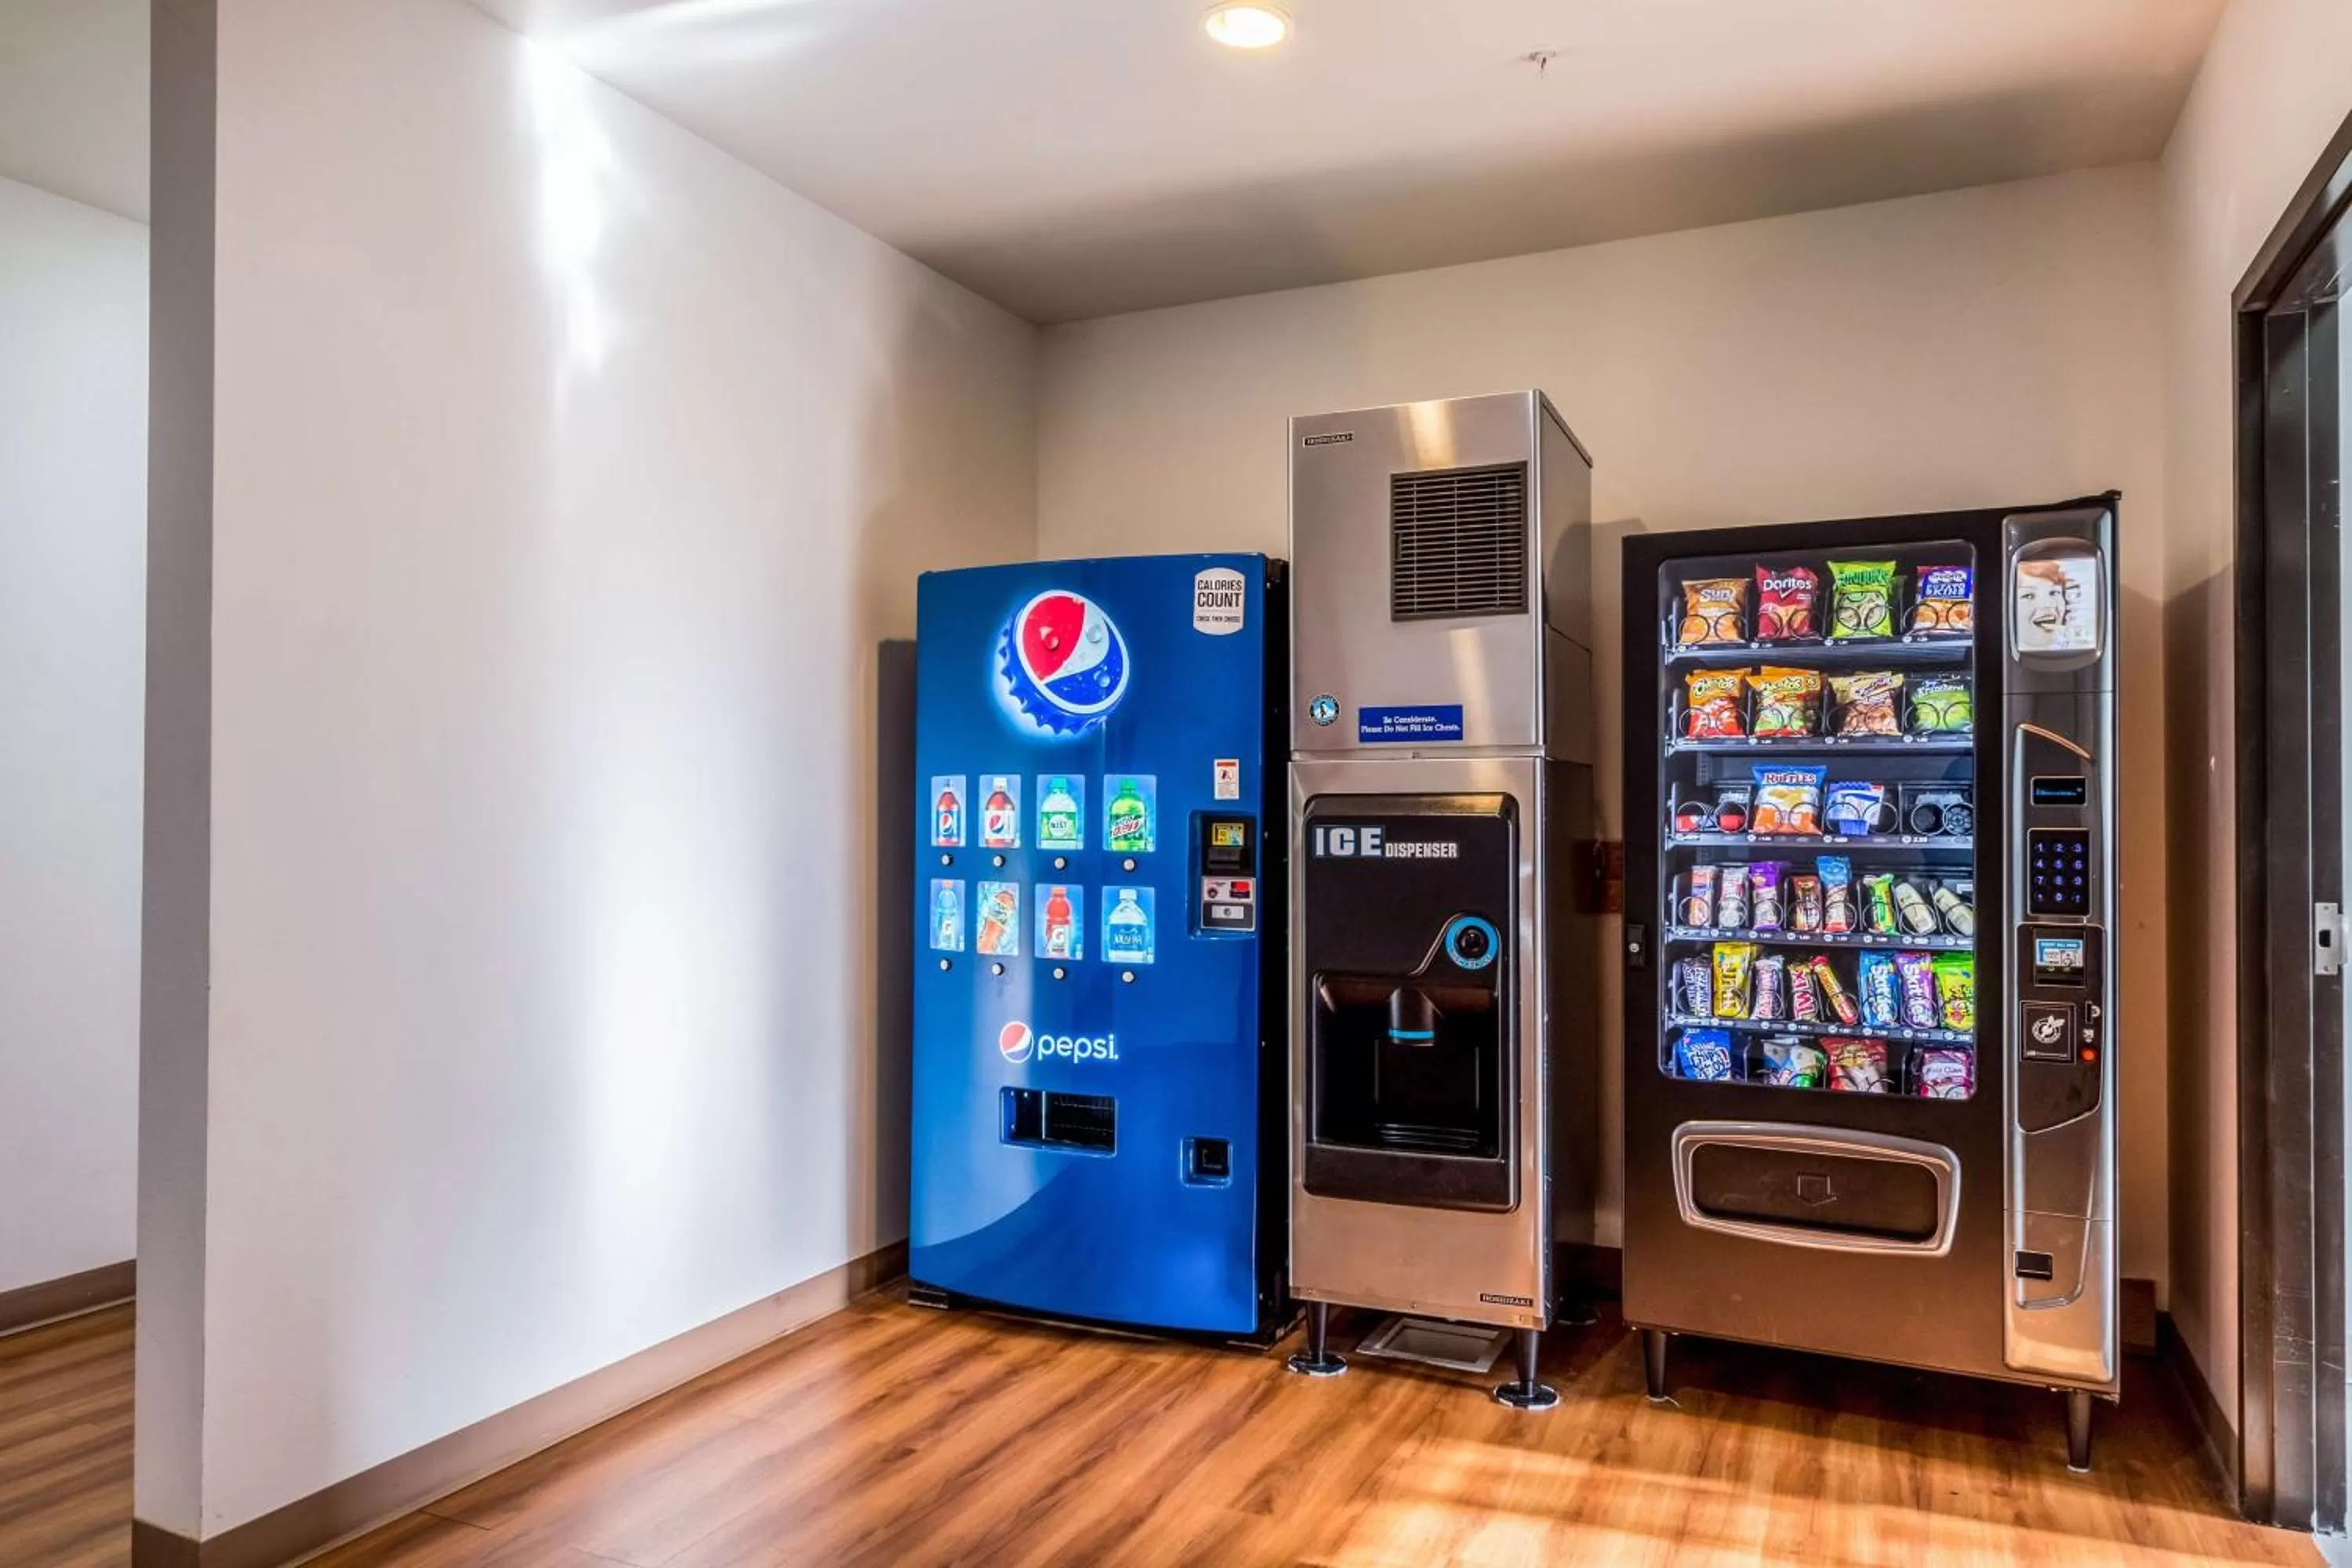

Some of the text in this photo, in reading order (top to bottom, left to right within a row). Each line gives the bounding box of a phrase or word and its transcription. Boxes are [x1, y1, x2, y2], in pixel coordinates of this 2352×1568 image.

[1197, 579, 1243, 591] CALORIES
[1763, 578, 1812, 590] Doritos
[1197, 592, 1242, 608] COUNT
[1315, 826, 1457, 858] ICE DISPENSER
[1051, 927, 1065, 943] G
[1870, 964, 1893, 1022] Skittles
[1904, 964, 1927, 1023] Skittles
